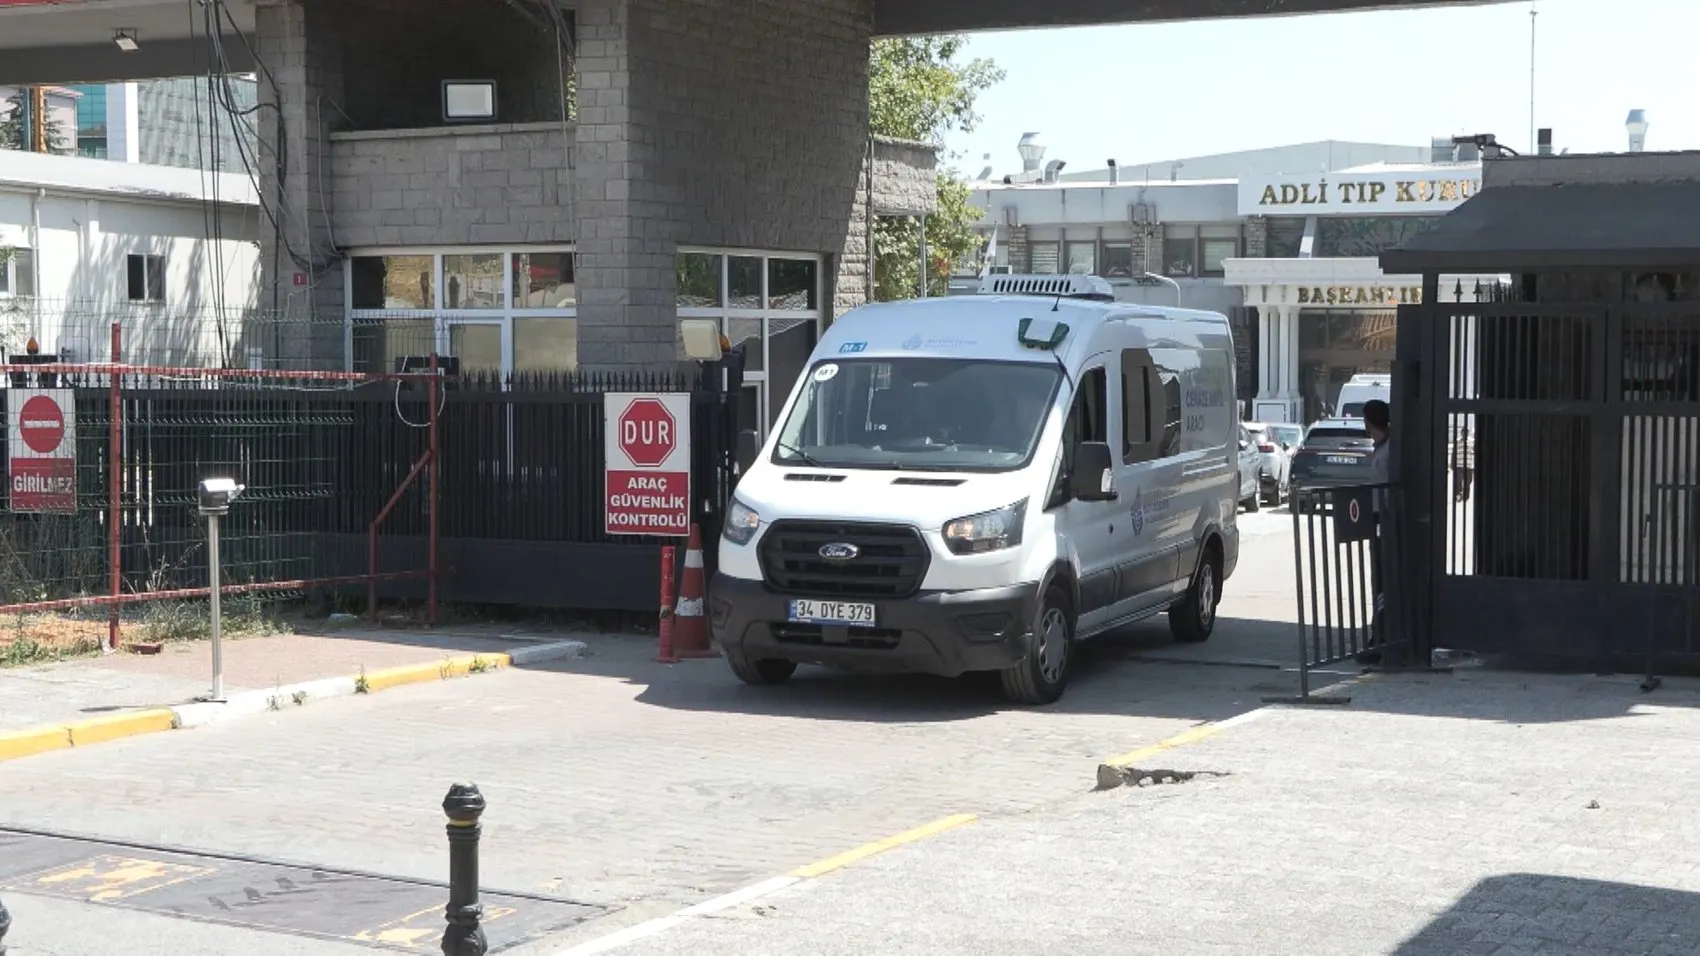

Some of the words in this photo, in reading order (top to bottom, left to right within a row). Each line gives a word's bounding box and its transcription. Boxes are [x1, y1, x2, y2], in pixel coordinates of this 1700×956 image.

[1259, 178, 1328, 204] ADLİ
[1338, 181, 1386, 204] TIP
[624, 420, 670, 445] DUR
[13, 472, 73, 494] GİRİLMEZ
[627, 477, 667, 491] ARAÇ
[611, 494, 684, 508] GÜVENLİK
[608, 512, 686, 528] KONTROLÜ
[798, 601, 813, 617] 34
[820, 602, 845, 619] DYE
[847, 604, 872, 621] 379
